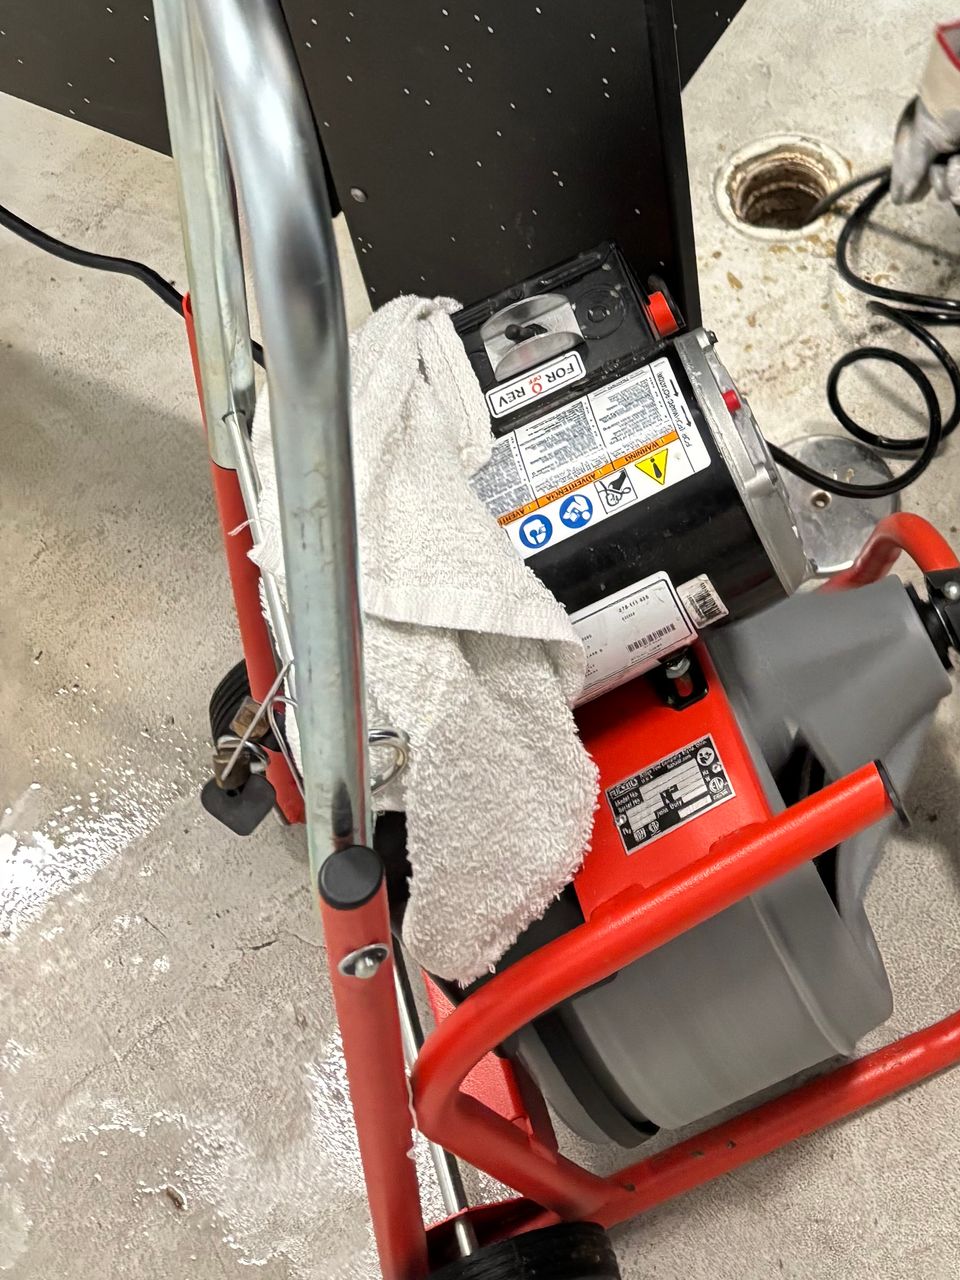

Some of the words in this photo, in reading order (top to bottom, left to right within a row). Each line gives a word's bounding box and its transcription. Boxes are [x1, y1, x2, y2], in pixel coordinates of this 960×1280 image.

[527, 374, 541, 384] OFF
[545, 362, 574, 383] FOR
[496, 386, 526, 407] REV
[624, 441, 659, 462] WARNING
